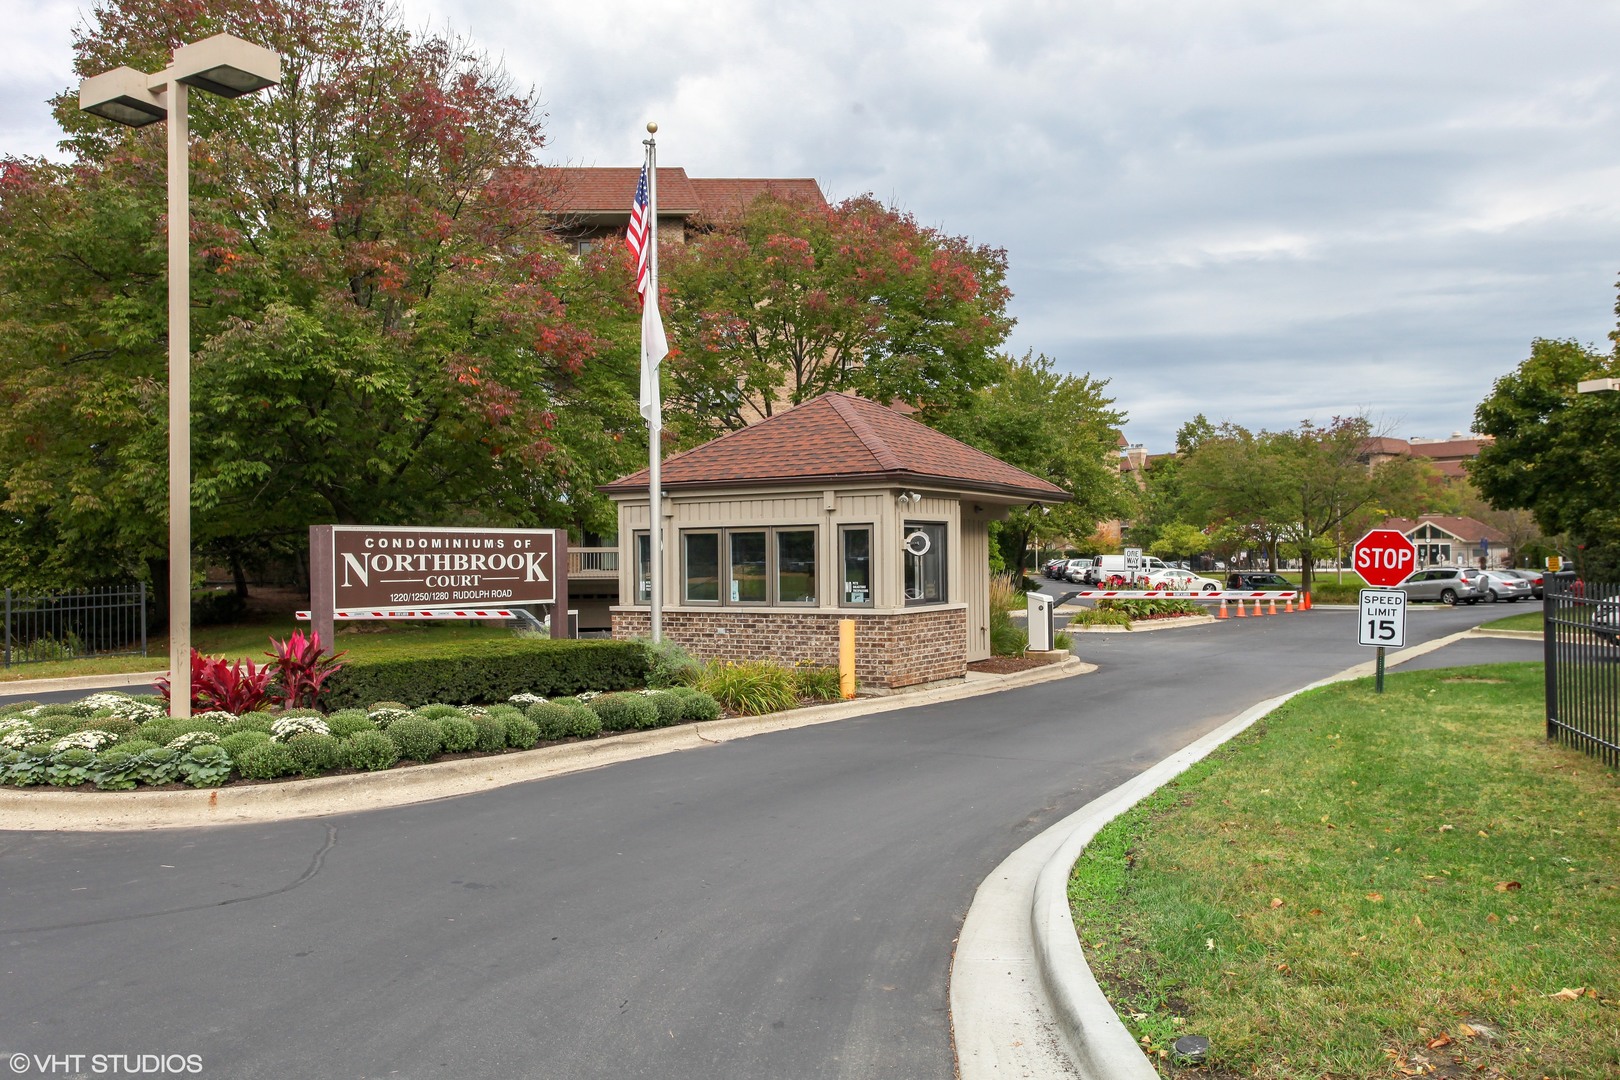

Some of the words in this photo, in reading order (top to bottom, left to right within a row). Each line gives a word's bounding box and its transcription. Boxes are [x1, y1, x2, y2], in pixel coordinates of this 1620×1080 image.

[365, 538, 504, 549] CONDOMINIUMS
[513, 539, 532, 549] OF
[1357, 547, 1412, 569] STOP
[341, 552, 549, 587] NORTHBROOK
[425, 574, 482, 588] COURT
[390, 591, 449, 602] 1220/1250/1280
[452, 590, 490, 600] RUDOLPH
[491, 589, 512, 598] ROAD
[1364, 595, 1402, 605] SPEED
[1368, 608, 1397, 617] LIMIT
[1368, 619, 1396, 640] 15
